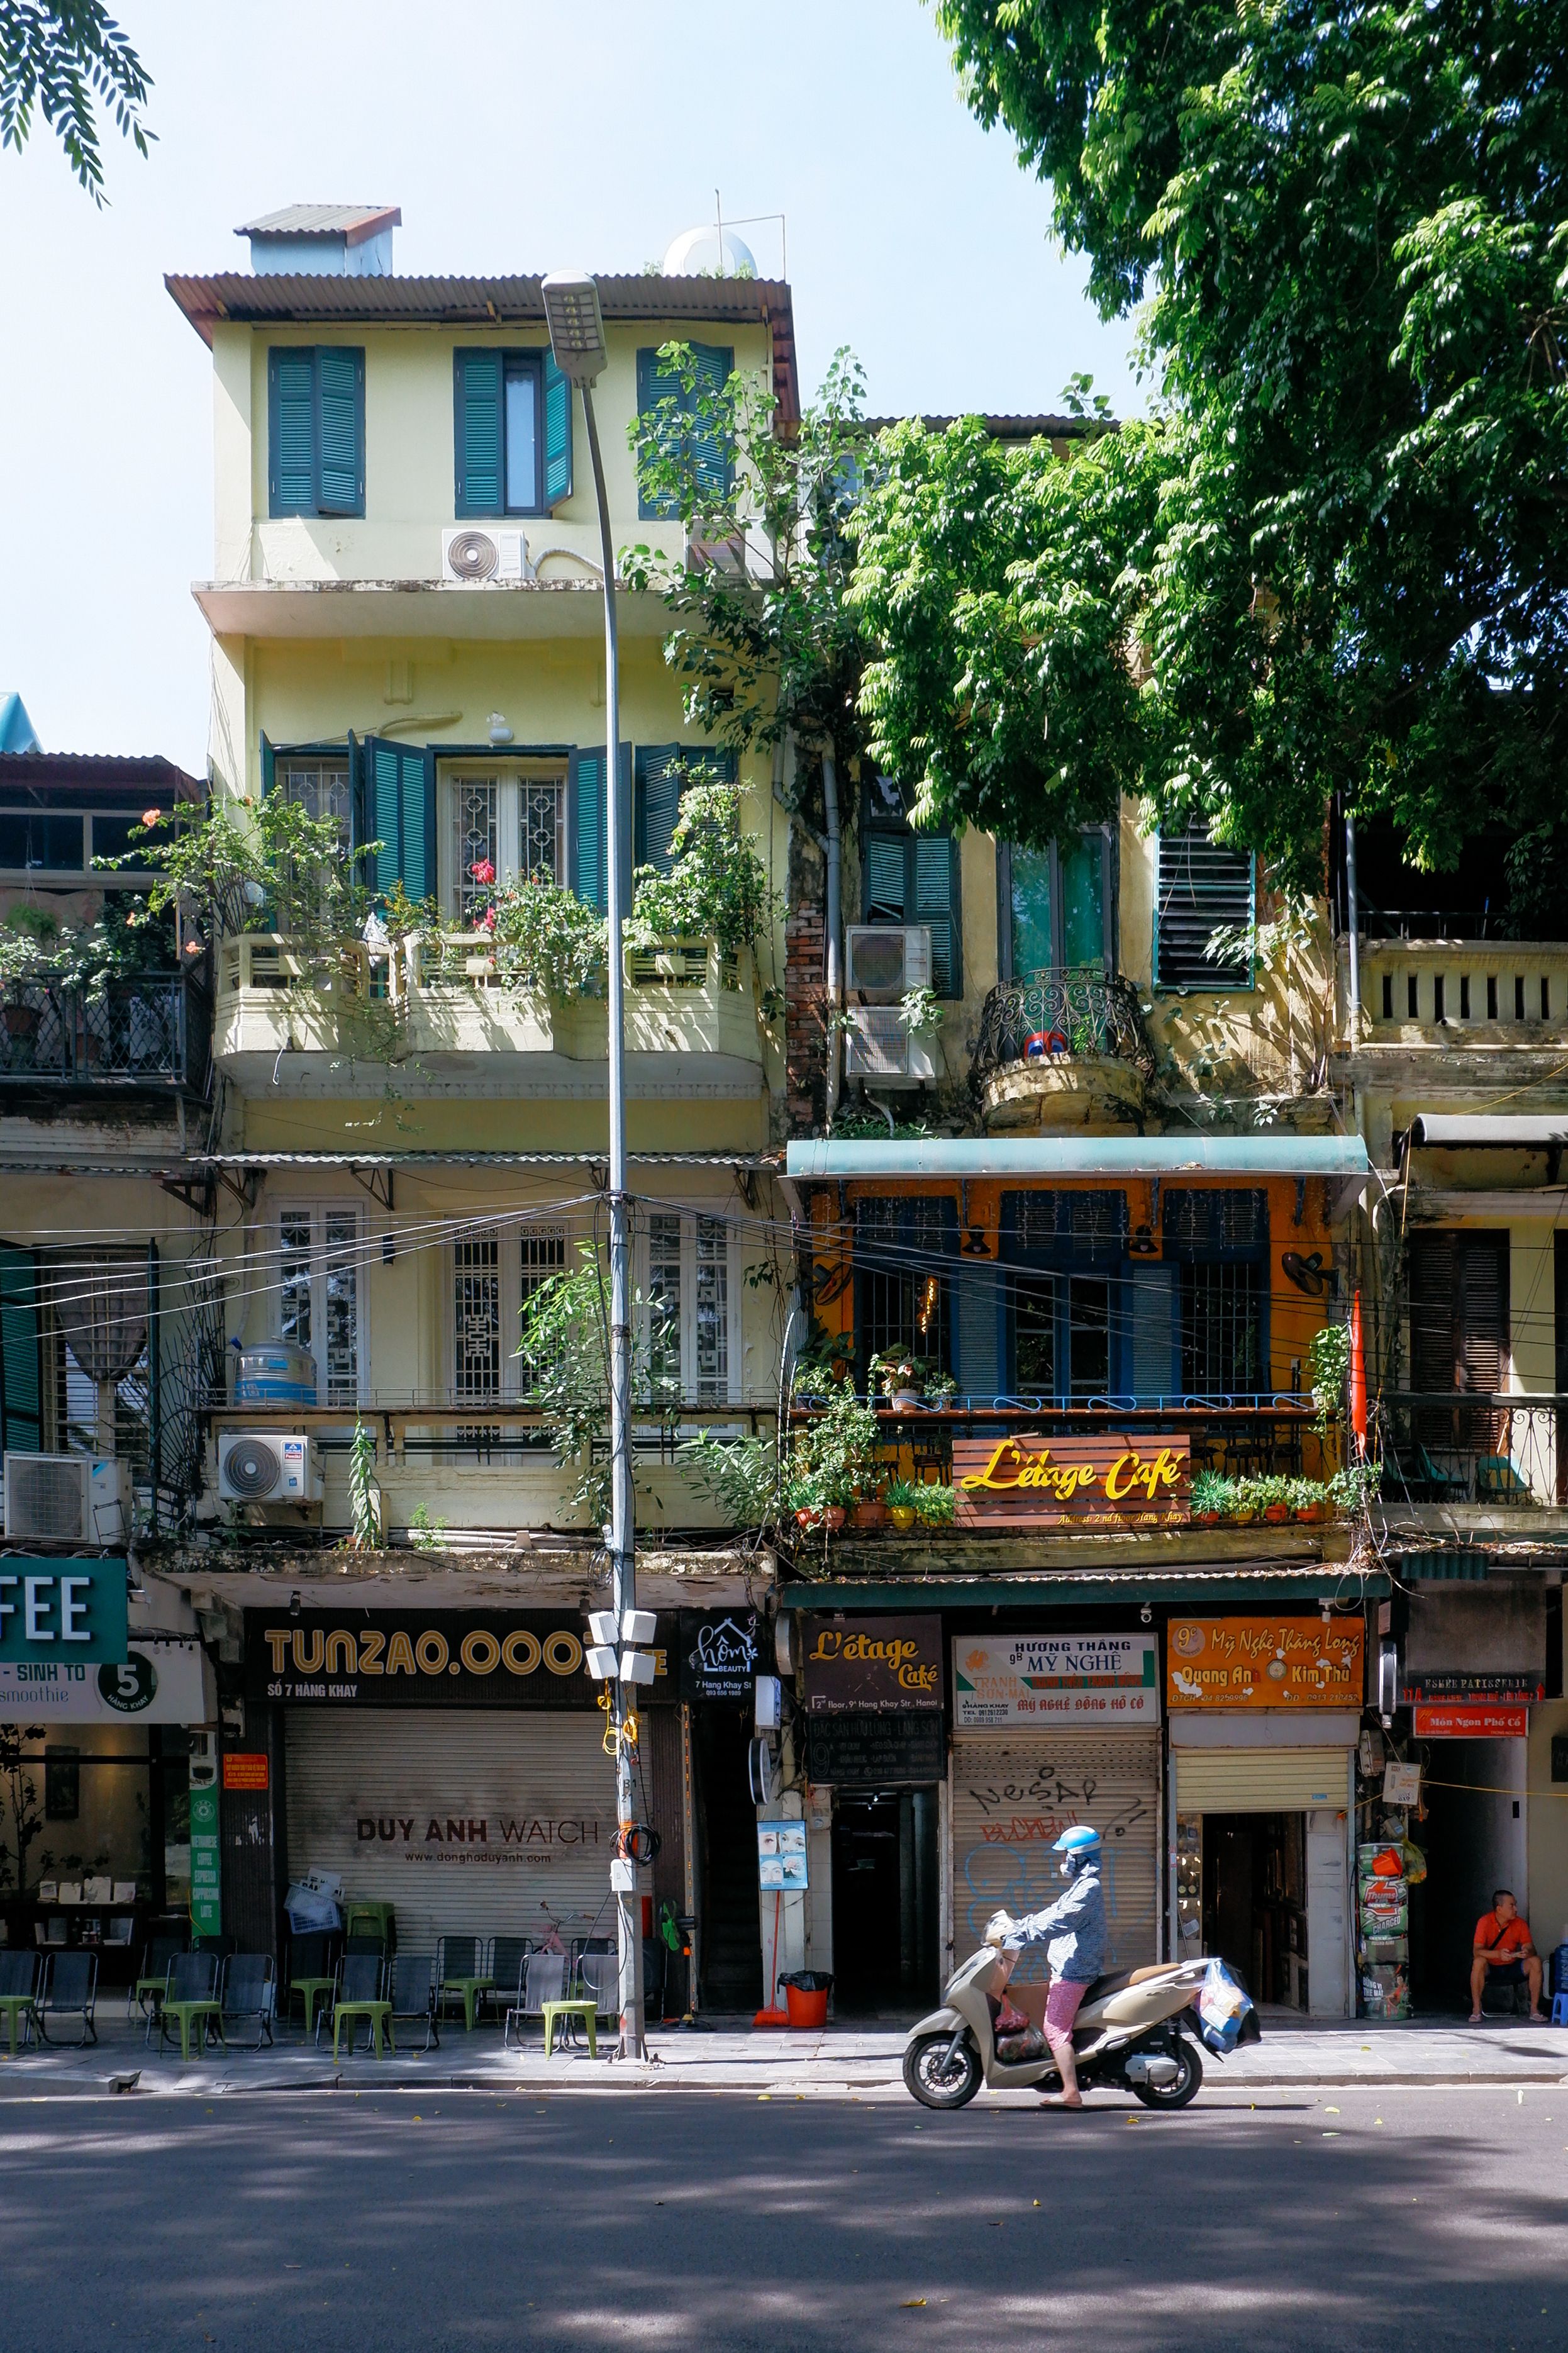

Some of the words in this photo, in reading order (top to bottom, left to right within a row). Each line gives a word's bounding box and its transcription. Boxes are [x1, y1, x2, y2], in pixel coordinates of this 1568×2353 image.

[960, 1439, 1097, 1500] L'étage
[1105, 1448, 1186, 1500] Café
[809, 1631, 919, 1670] L'étage
[1015, 1641, 1070, 1652] HƯƠNG
[1325, 1627, 1360, 1657] Long
[1009, 1652, 1023, 1665] 9B
[1026, 1651, 1057, 1672] MỸ
[1065, 1651, 1122, 1674] NGHỆ
[18, 1664, 58, 1682] SINH
[117, 1665, 139, 1697] 5
[898, 1663, 938, 1692] Café
[1181, 1666, 1228, 1687] Quang
[1291, 1665, 1319, 1682] Kim
[286, 1684, 292, 1696] 7
[296, 1682, 326, 1697] HÀNG
[329, 1685, 357, 1697] KHAY
[702, 1681, 721, 1690] Hang
[723, 1681, 742, 1690] Khay
[972, 1677, 1017, 1688] TRANH
[0, 1686, 69, 1703] smoothie
[107, 1694, 128, 1710] HÀNG
[130, 1695, 149, 1709] KHAY
[1403, 1686, 1422, 1701] 11A
[859, 1700, 877, 1709] Hang
[881, 1700, 898, 1709] Khay
[1430, 1717, 1453, 1726] Món
[1455, 1718, 1481, 1728] Ngon
[1484, 1716, 1505, 1726] Phố
[1507, 1716, 1521, 1726] Cổ
[356, 1818, 415, 1842] DUY
[425, 1819, 487, 1842] ANH
[499, 1820, 598, 1844] WATCH
[405, 1852, 551, 1864] www.donghoduyanh.com
[1373, 1915, 1401, 1935] CHARGED
